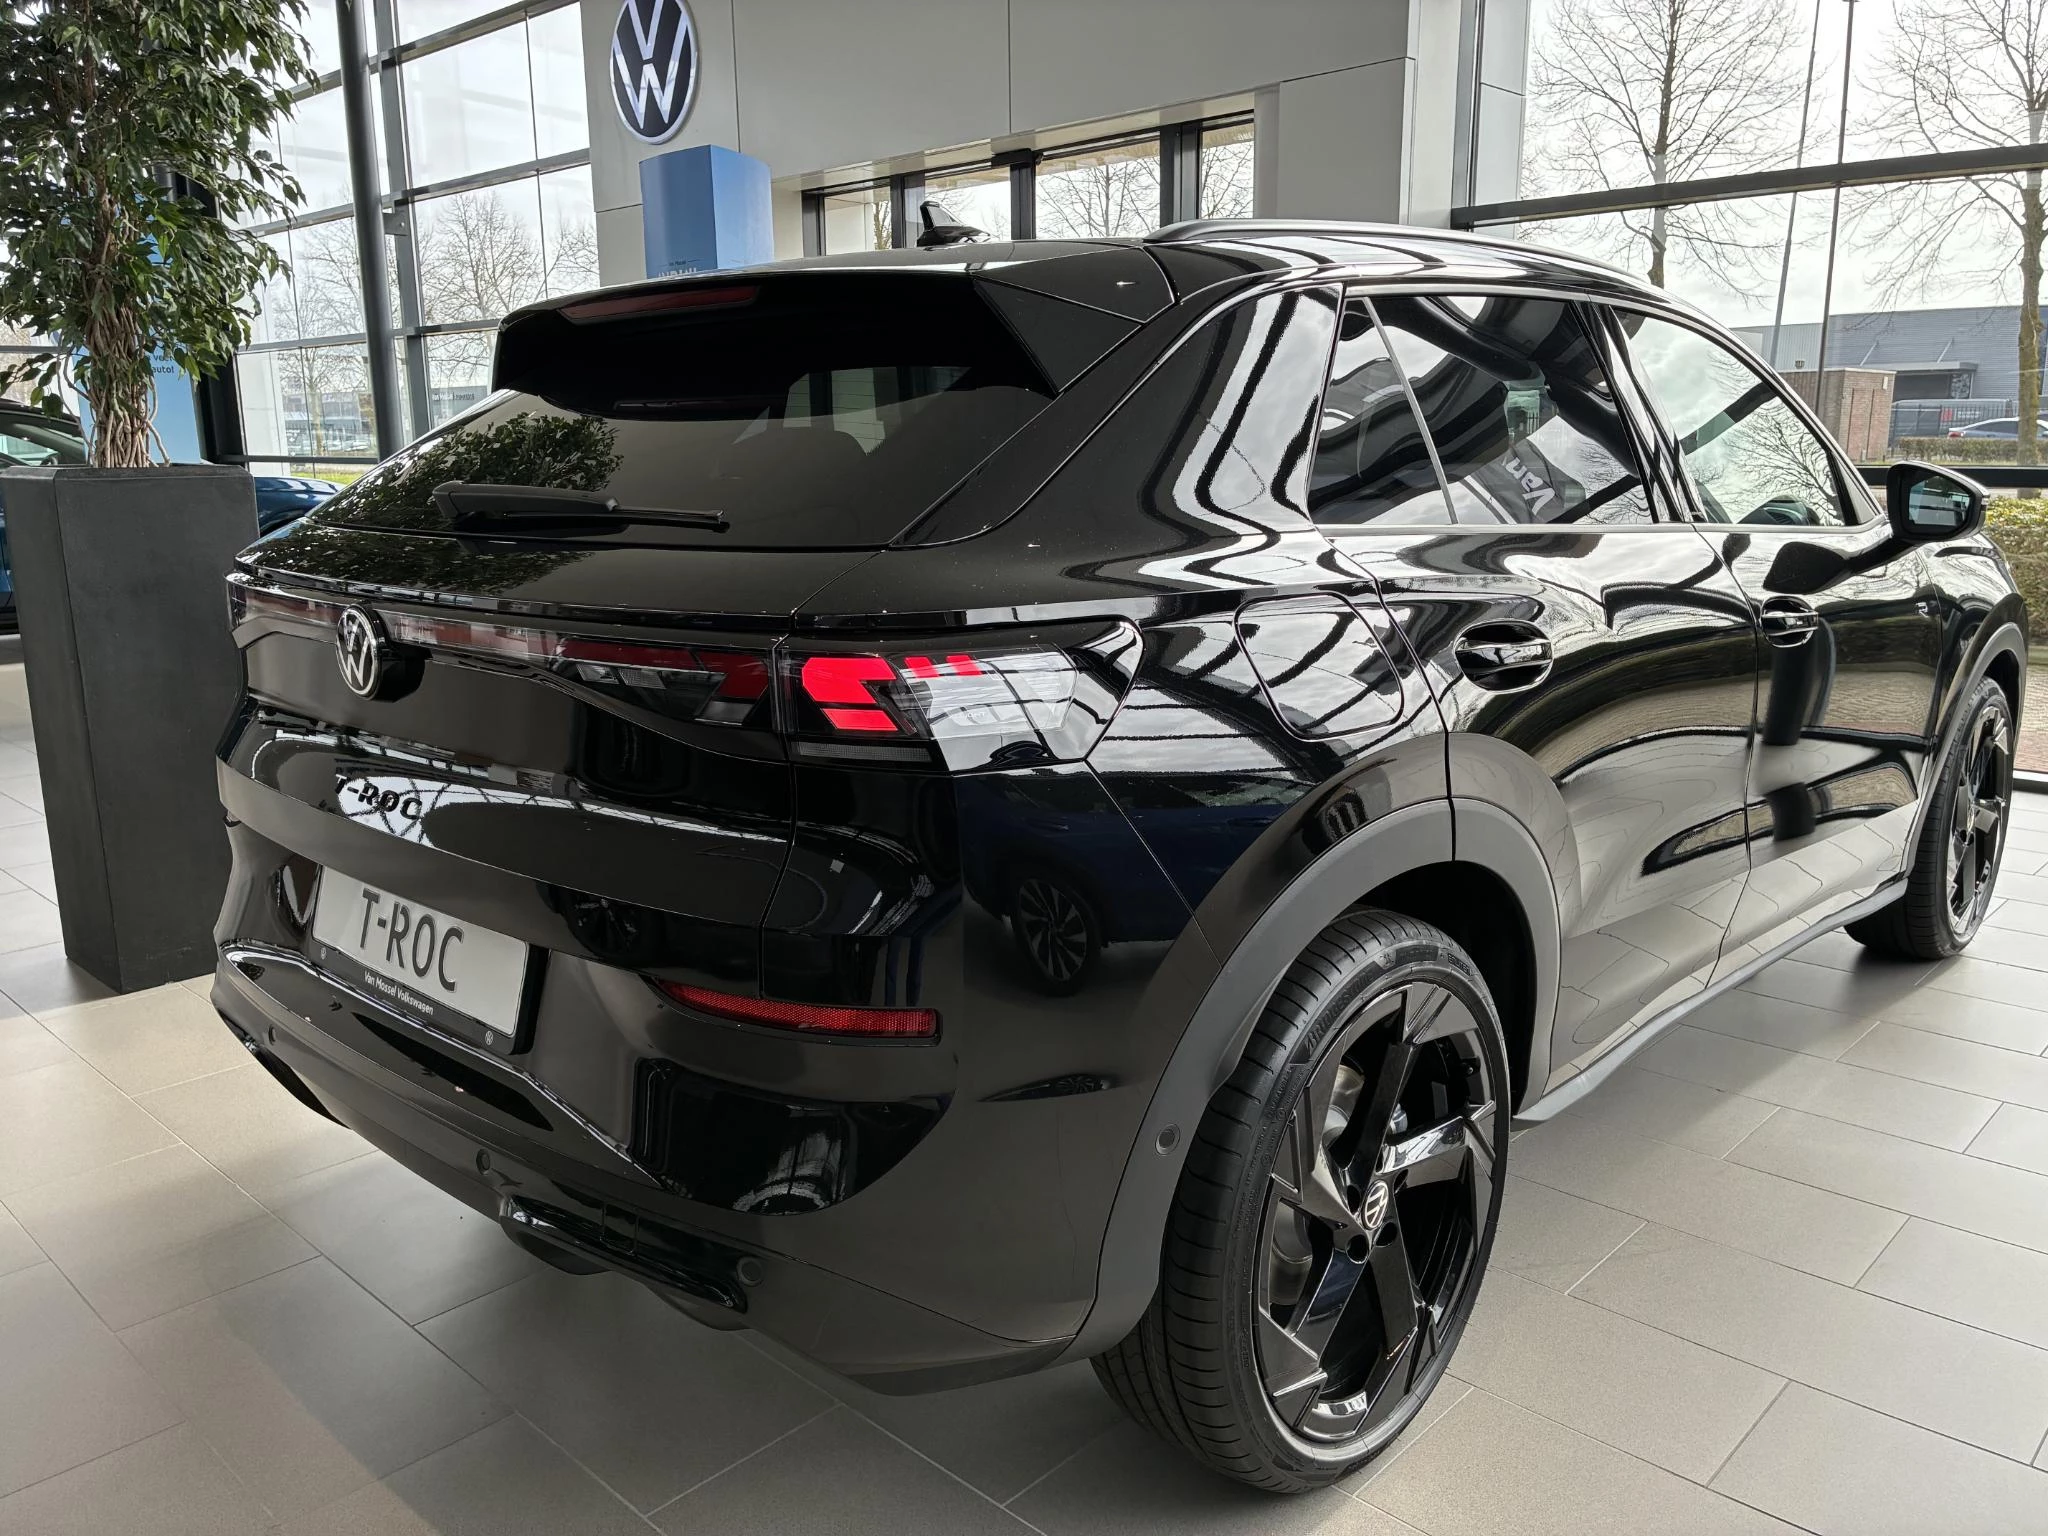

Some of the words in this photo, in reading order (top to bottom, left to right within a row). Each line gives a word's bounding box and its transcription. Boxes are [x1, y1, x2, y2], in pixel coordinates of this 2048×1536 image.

[334, 773, 423, 821] T-ROC
[359, 887, 465, 993] T-ROC
[364, 970, 376, 986] Van
[376, 976, 398, 997] Mossel
[397, 987, 434, 1015] Volkswagen
